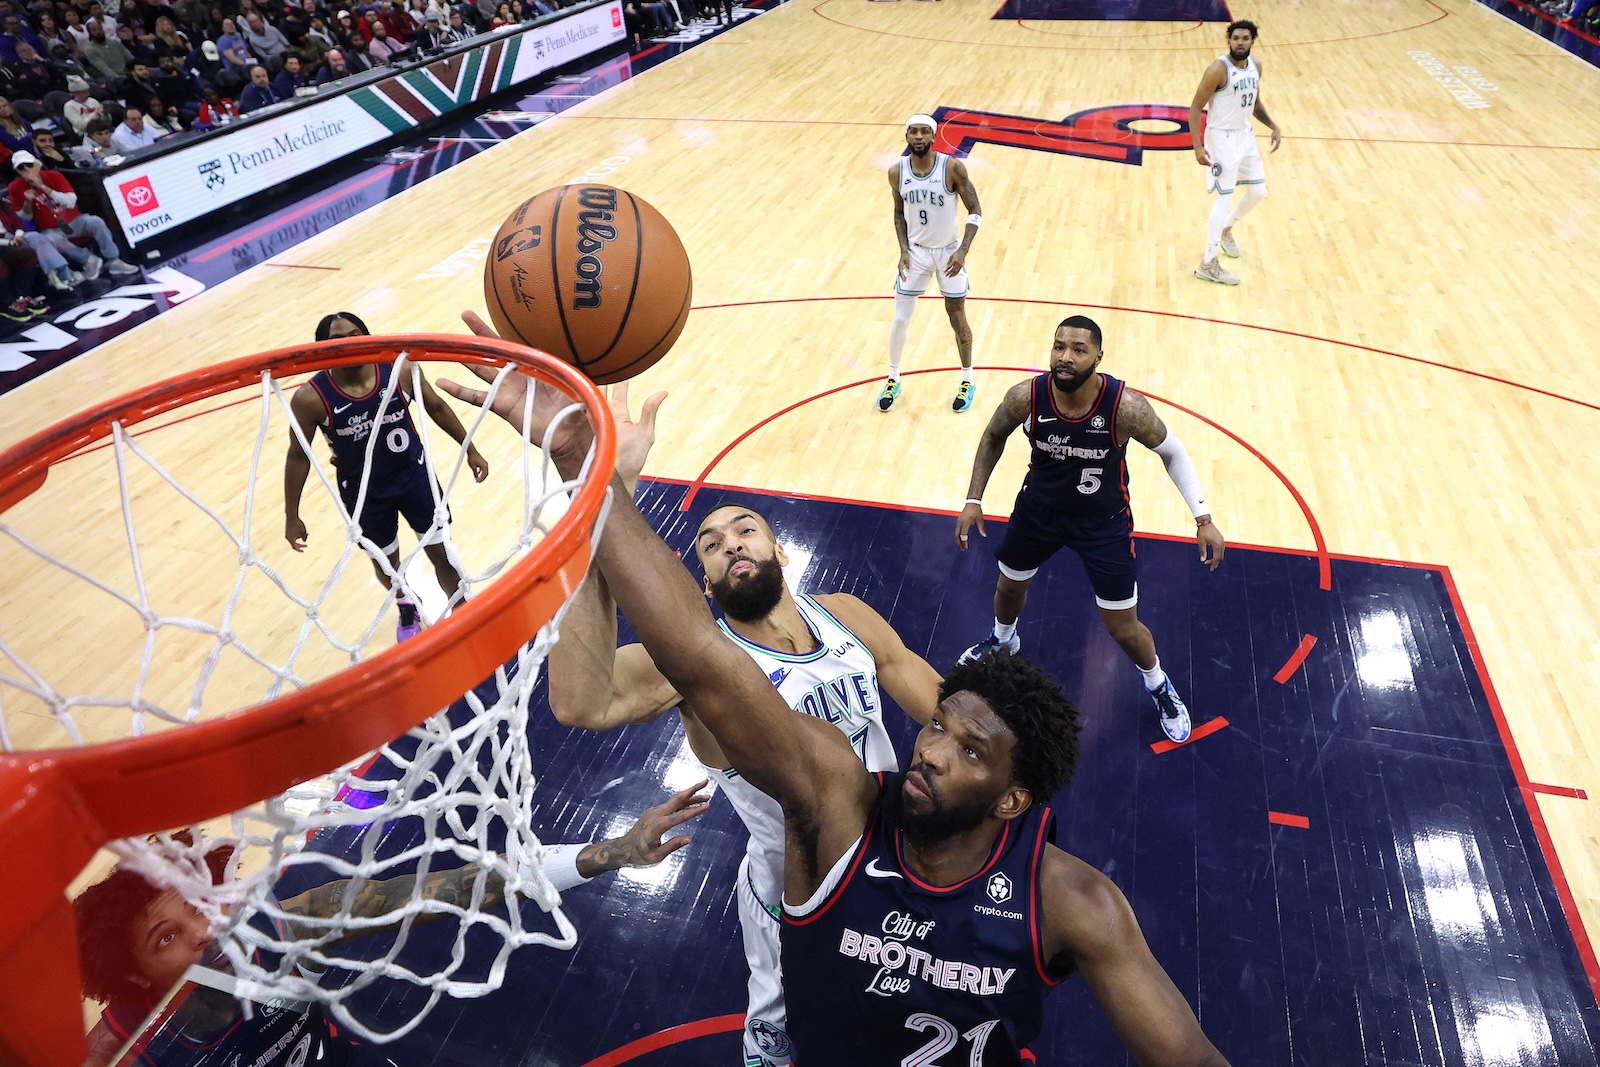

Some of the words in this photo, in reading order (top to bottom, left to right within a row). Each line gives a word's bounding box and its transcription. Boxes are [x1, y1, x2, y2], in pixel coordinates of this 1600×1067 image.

[545, 35, 567, 52] Penn
[565, 24, 599, 45] Medicine
[1233, 77, 1259, 93] WOLVE
[1241, 93, 1254, 108] 32
[226, 147, 275, 175] Penn
[273, 119, 345, 157] Medicine
[128, 213, 173, 236] TOYOTA
[919, 209, 928, 226] 9
[573, 187, 618, 311] Wilson
[386, 427, 410, 453] 0
[1035, 439, 1110, 460] BROTHERLY
[1047, 434, 1062, 446] City
[1076, 467, 1104, 495] 5
[793, 671, 880, 726] OLVE
[881, 910, 918, 942] City
[916, 920, 936, 941] of
[973, 903, 1023, 921] crypto.com
[839, 927, 1016, 996] BROTHERLY
[864, 966, 911, 997] Love
[259, 999, 300, 1034] cryptocom
[900, 1012, 1001, 1067] 21
